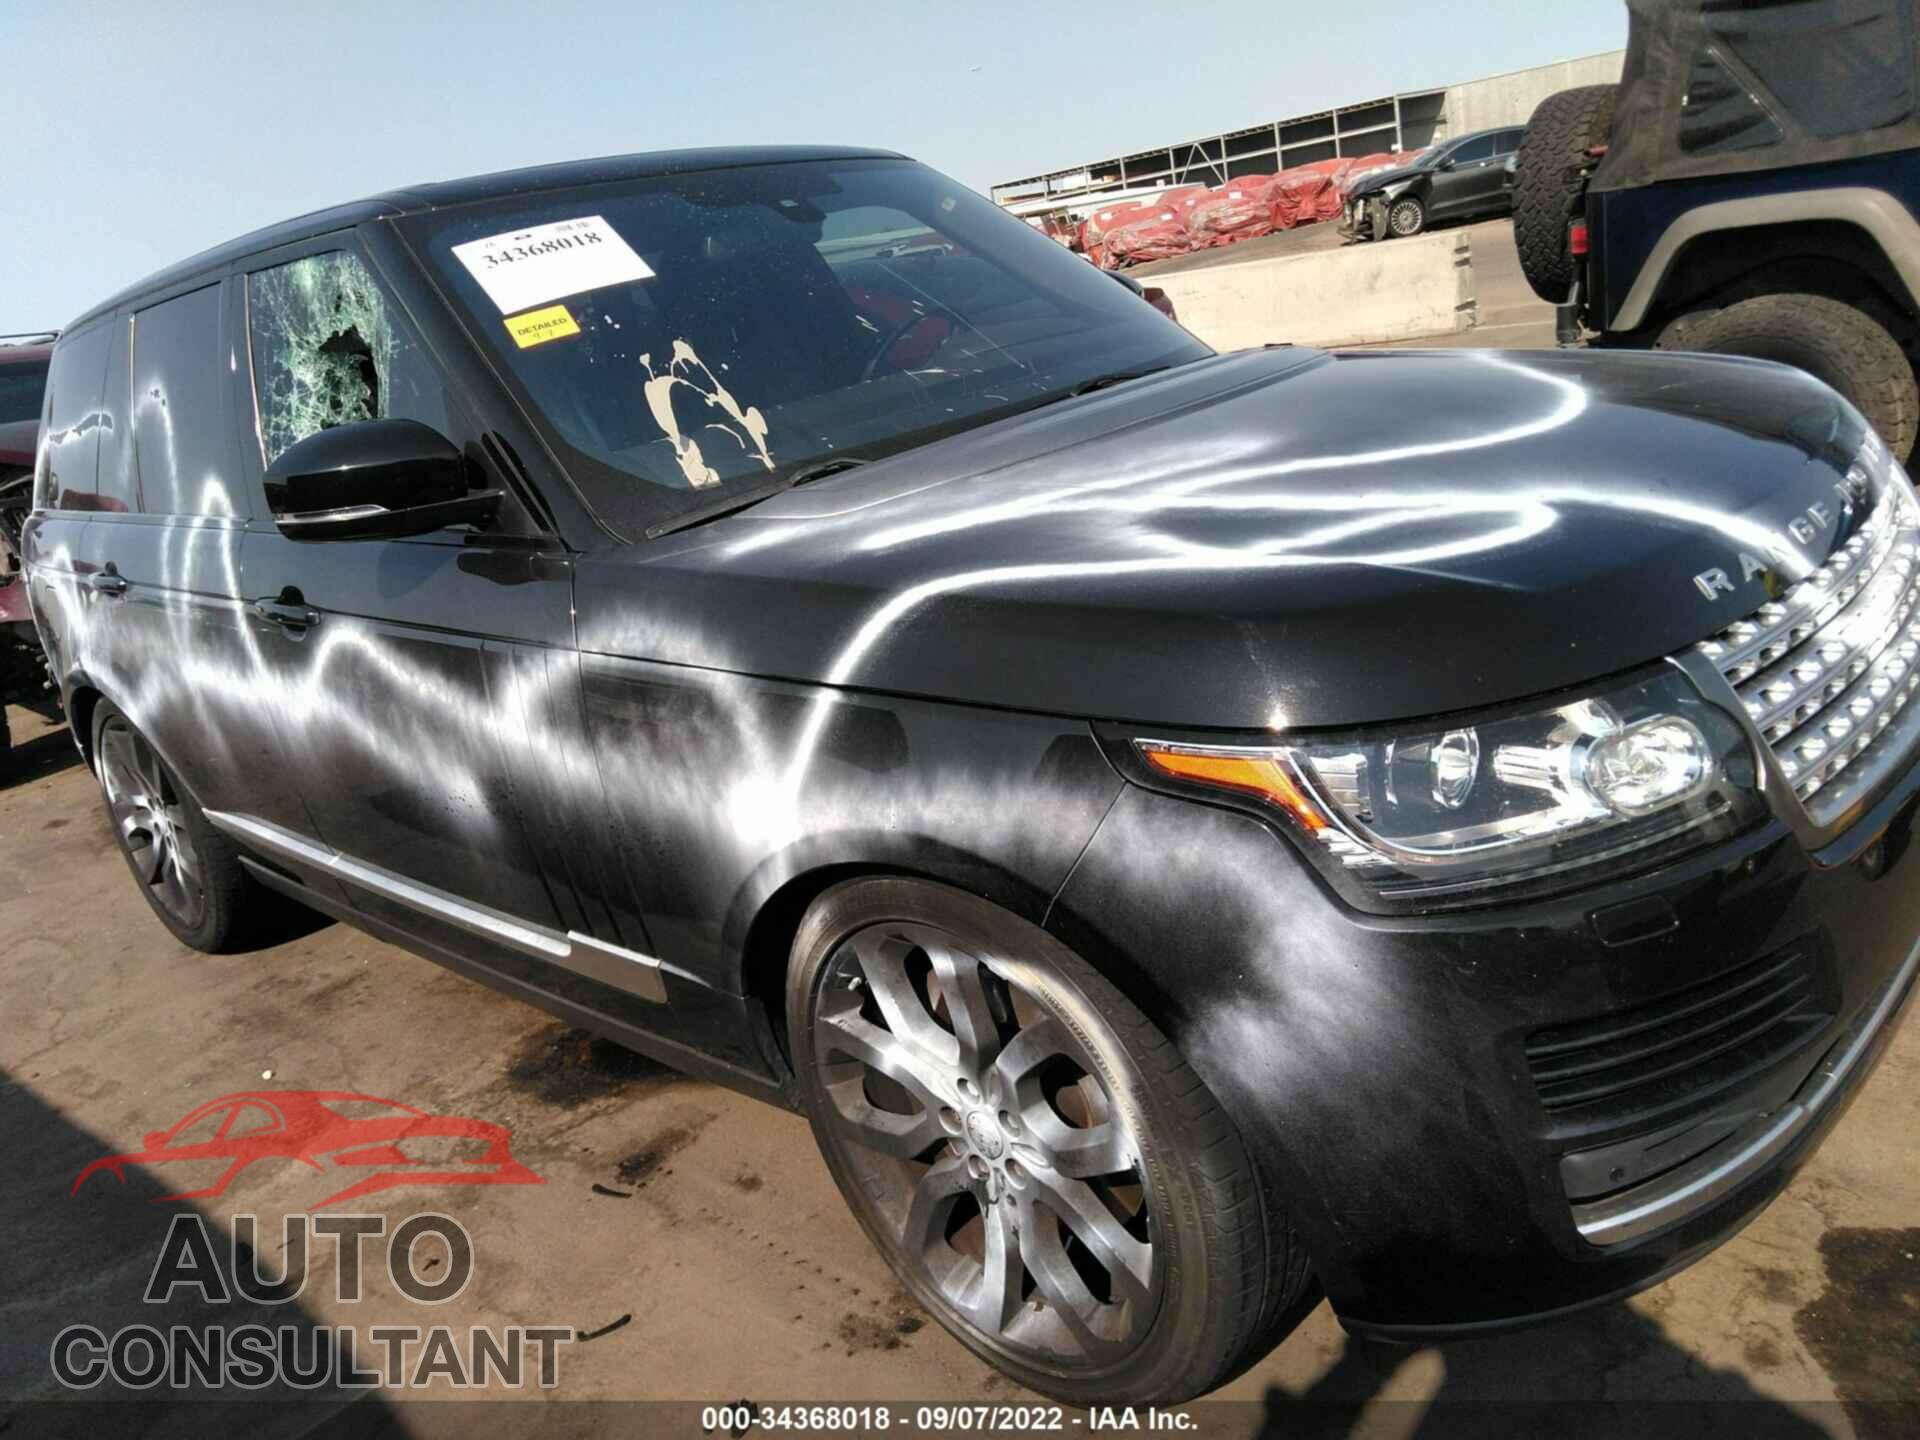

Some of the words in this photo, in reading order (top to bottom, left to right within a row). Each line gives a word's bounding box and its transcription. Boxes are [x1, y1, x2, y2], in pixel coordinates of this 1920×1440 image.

[482, 231, 602, 268] 34368018
[517, 317, 568, 336] DETAILED
[1693, 501, 1830, 601] RAGE
